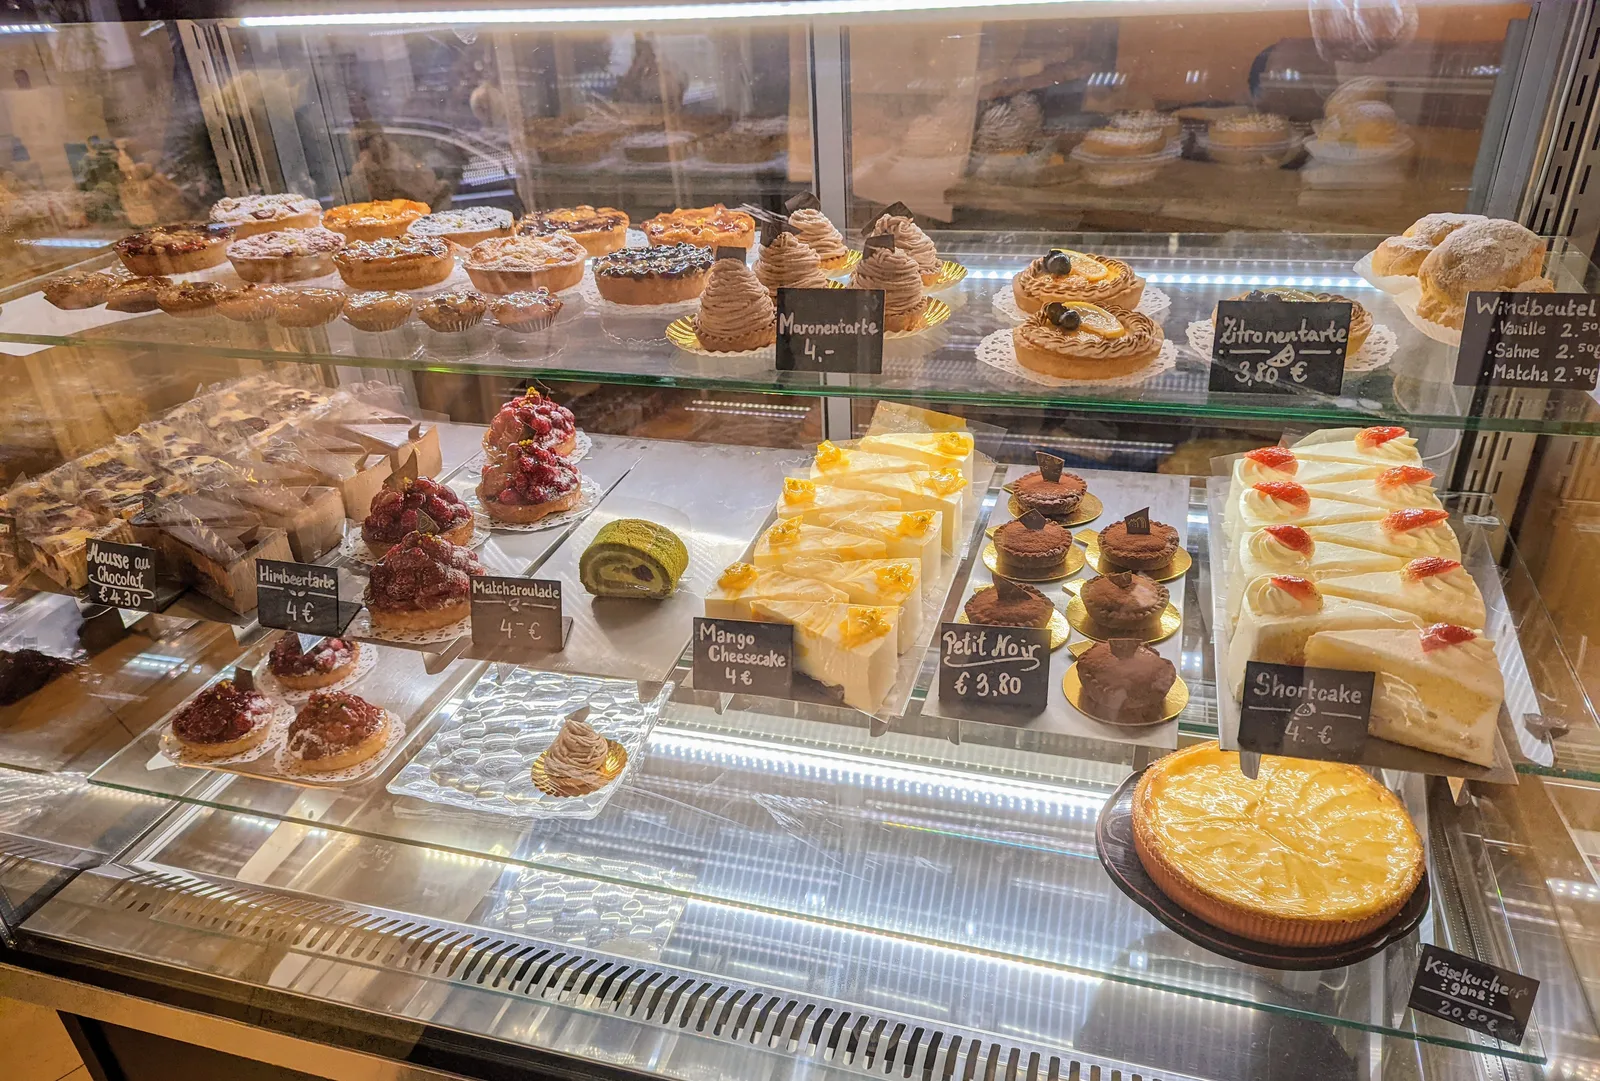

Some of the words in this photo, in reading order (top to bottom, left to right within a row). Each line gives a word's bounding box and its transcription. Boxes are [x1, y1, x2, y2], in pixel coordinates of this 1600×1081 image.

[1476, 296, 1597, 317] Windbeutel
[779, 311, 879, 335] Maronentarte
[1219, 316, 1348, 344] Zitronentarte
[1500, 320, 1546, 336] Vanille
[1560, 321, 1600, 338] 2.50
[1494, 342, 1540, 359] Sahne
[1234, 360, 1279, 386] 3,80
[1289, 361, 1308, 383] €
[1492, 364, 1548, 382] Matcha
[86, 542, 130, 570] Mousse
[134, 556, 151, 571] au
[97, 565, 144, 590] Chocolat
[259, 564, 336, 590] Himbeertarte
[472, 580, 560, 599] Matcharoulade
[528, 621, 541, 640] €
[700, 622, 755, 650] Mango
[942, 630, 987, 656] Petit
[991, 633, 1041, 658] Noir
[708, 645, 786, 668] Cheesecake
[953, 671, 971, 695] €
[1253, 671, 1362, 704] Shortcake
[1317, 725, 1333, 745] €
